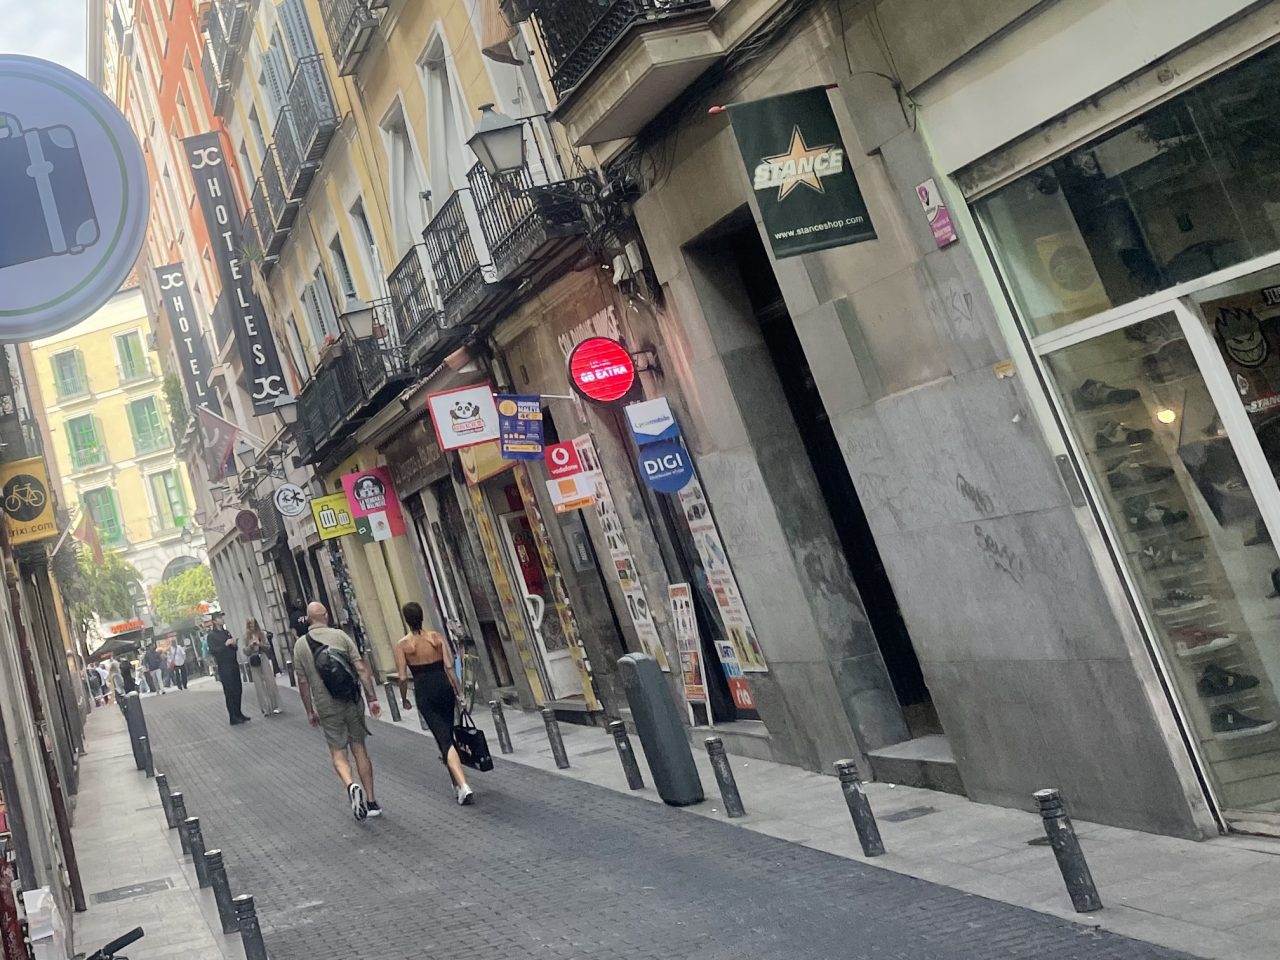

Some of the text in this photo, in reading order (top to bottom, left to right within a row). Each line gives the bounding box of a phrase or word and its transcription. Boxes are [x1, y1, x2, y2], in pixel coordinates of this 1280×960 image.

[754, 148, 843, 189] STANCE
[774, 215, 864, 240] www.stanceshop.com
[207, 176, 266, 365] HOTELES
[644, 453, 683, 475] DIGI
